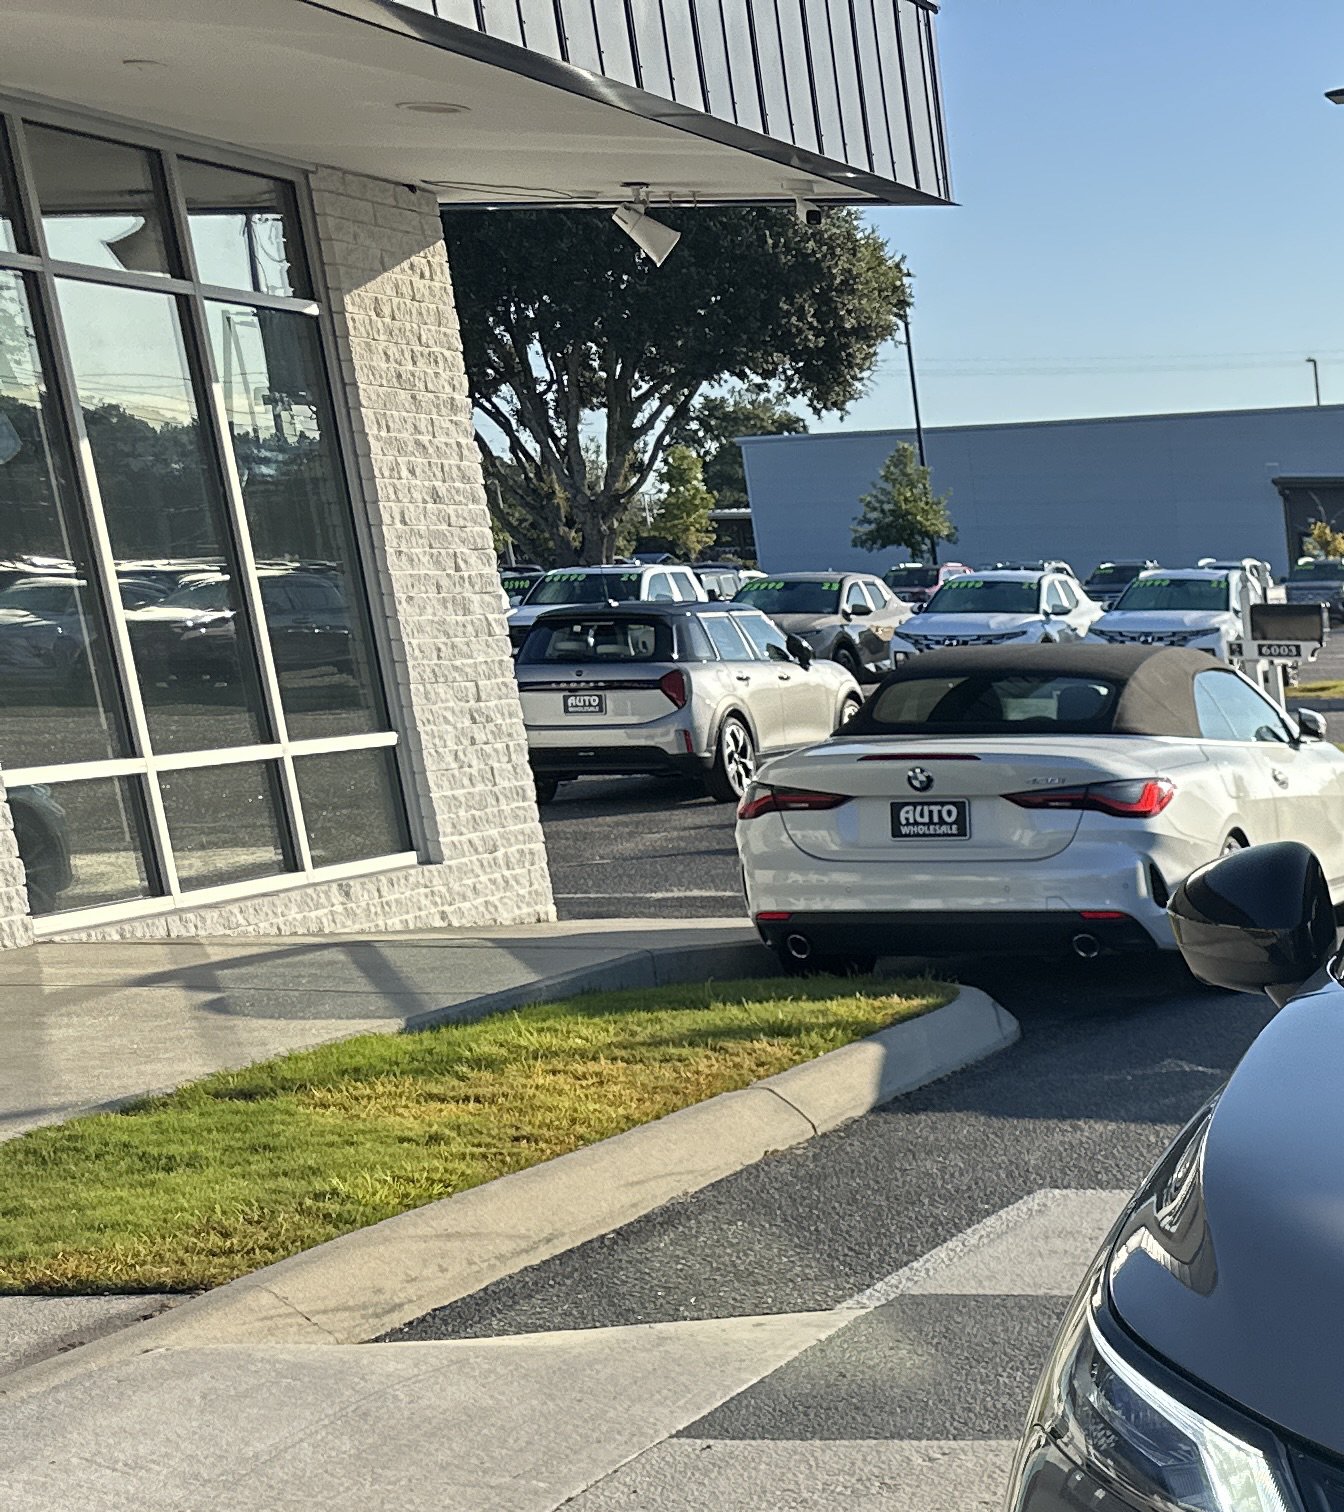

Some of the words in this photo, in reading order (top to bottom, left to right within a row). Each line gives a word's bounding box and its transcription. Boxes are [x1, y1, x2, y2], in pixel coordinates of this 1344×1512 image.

[1261, 645, 1297, 656] 6003
[567, 695, 600, 706] AUTO
[900, 804, 958, 825] AUTO
[900, 824, 959, 836] WHOLESALE
